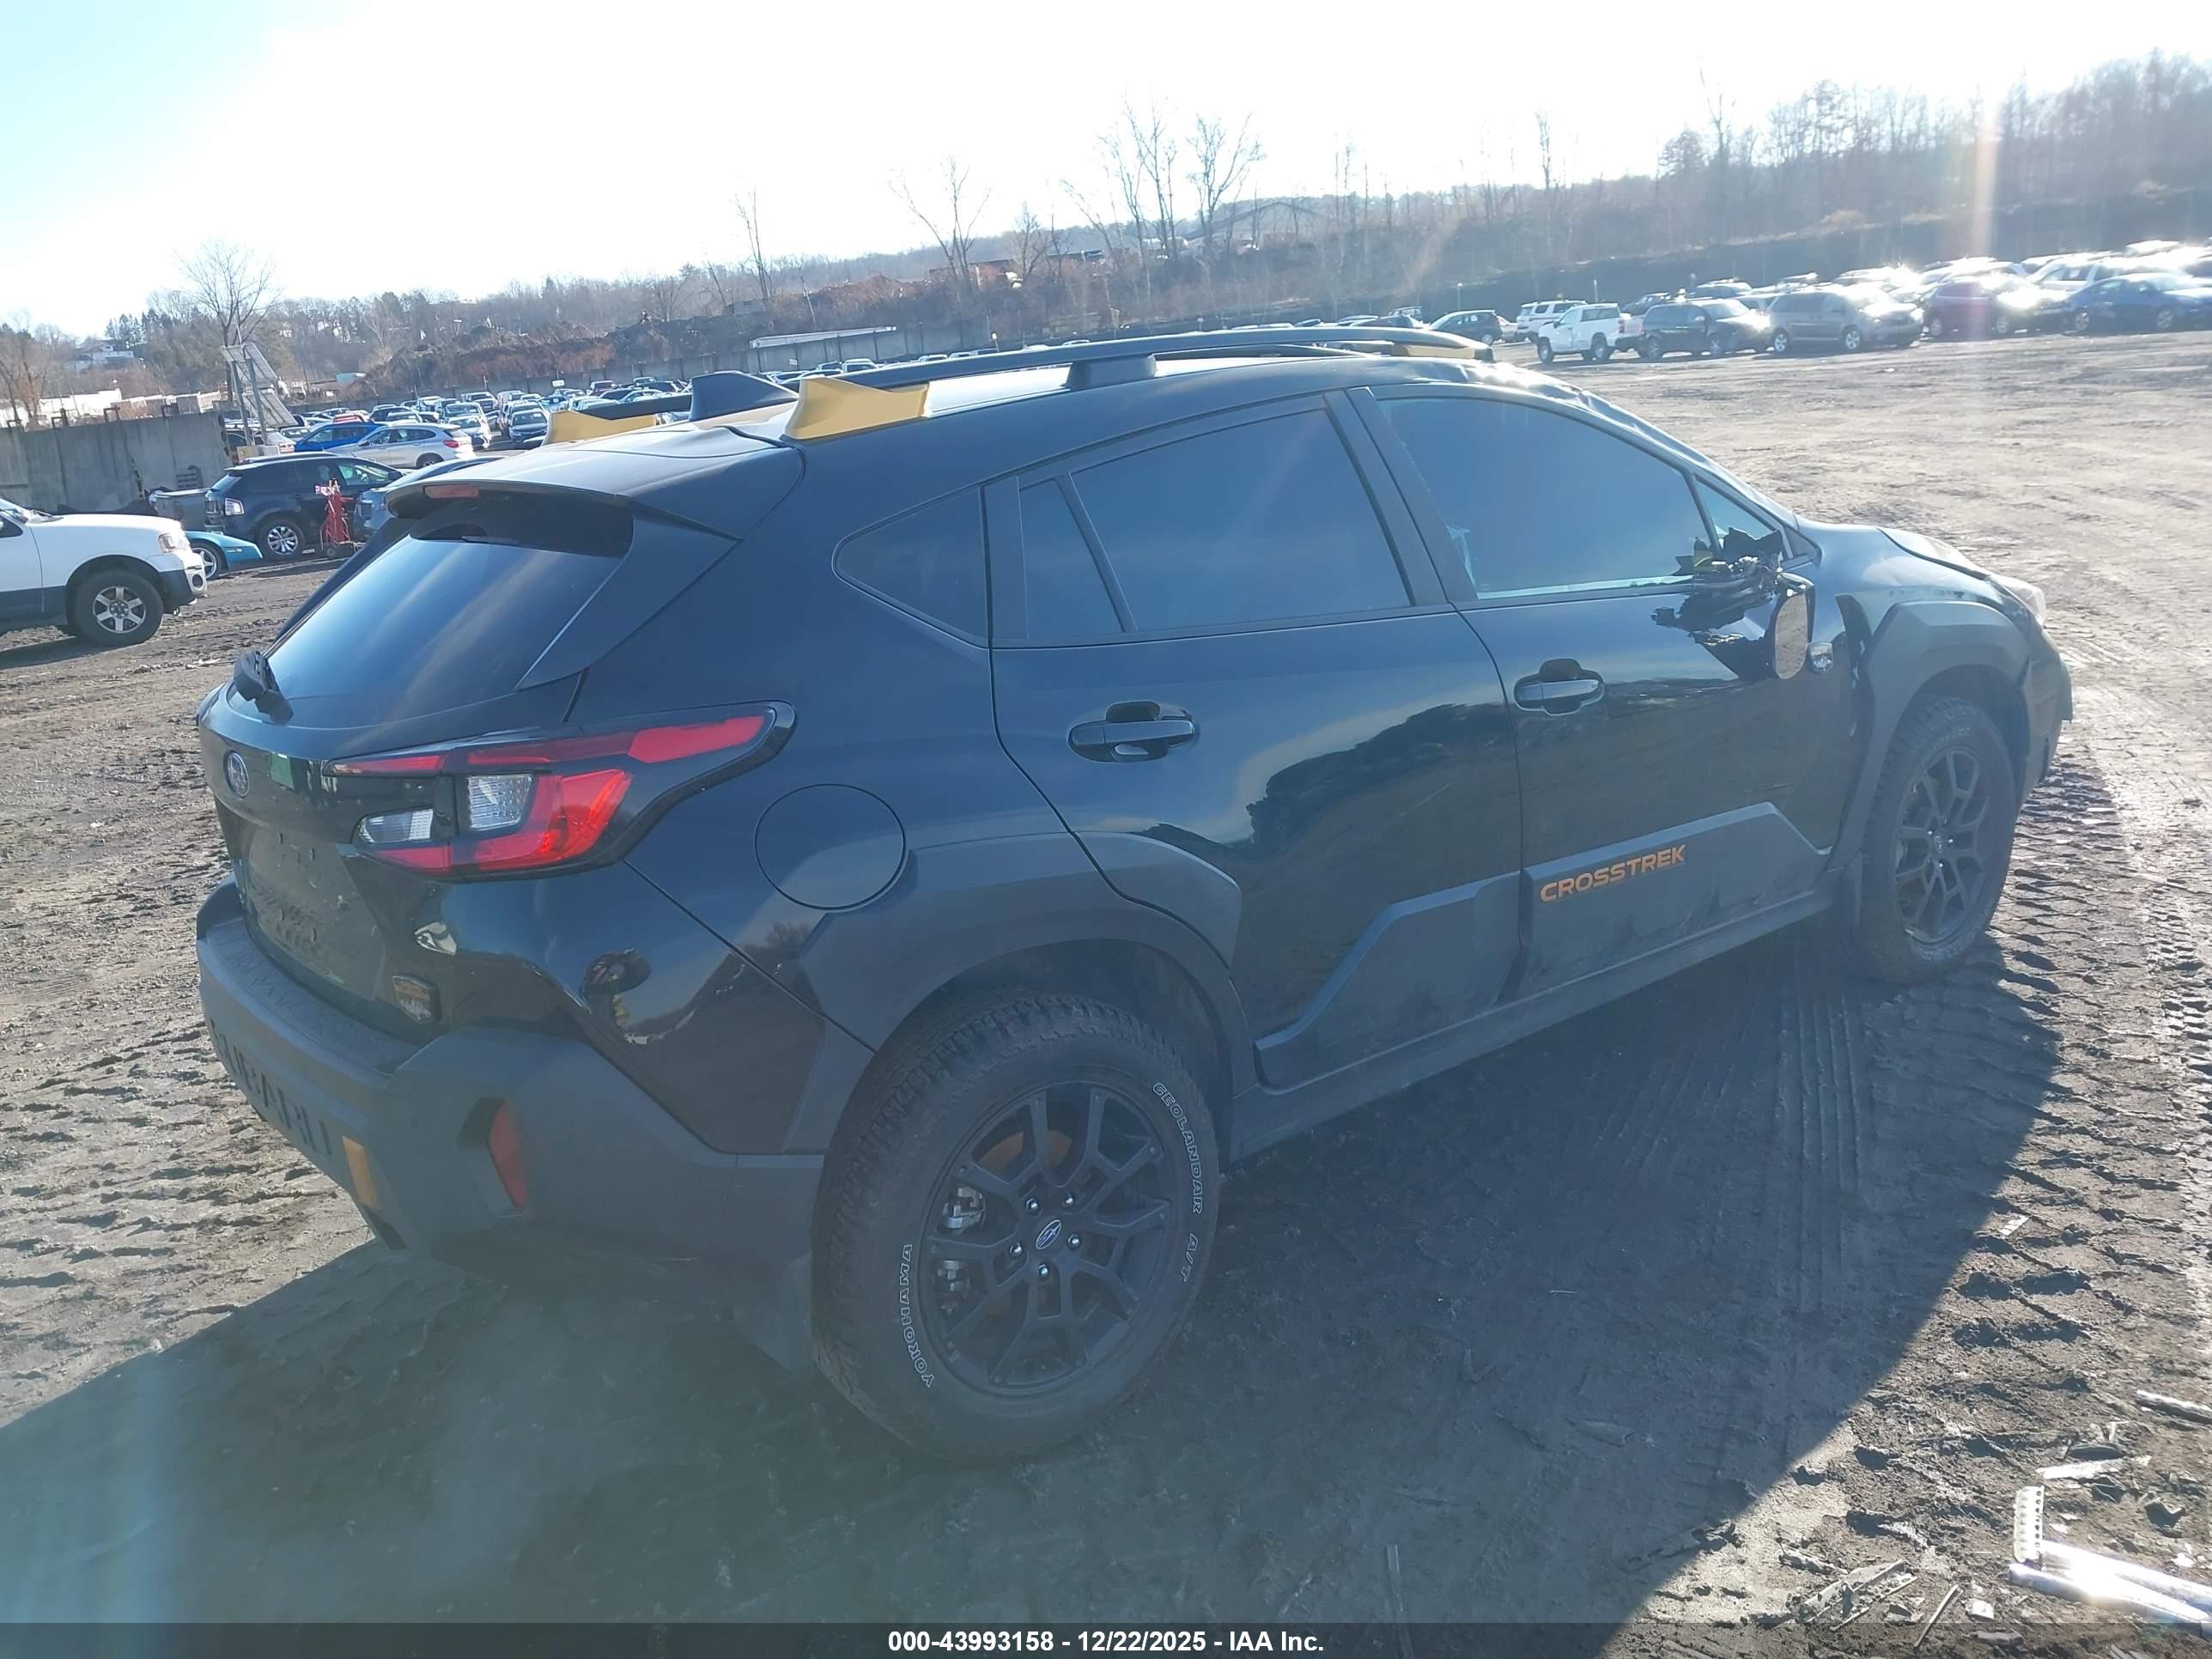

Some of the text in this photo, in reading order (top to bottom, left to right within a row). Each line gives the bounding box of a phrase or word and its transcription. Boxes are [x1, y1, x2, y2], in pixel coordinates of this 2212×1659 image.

[1539, 844, 1686, 902] CROSSTREK
[1152, 1082, 1203, 1283] GEOLANDAR A/T
[899, 1243, 935, 1389] YOKOHAMA
